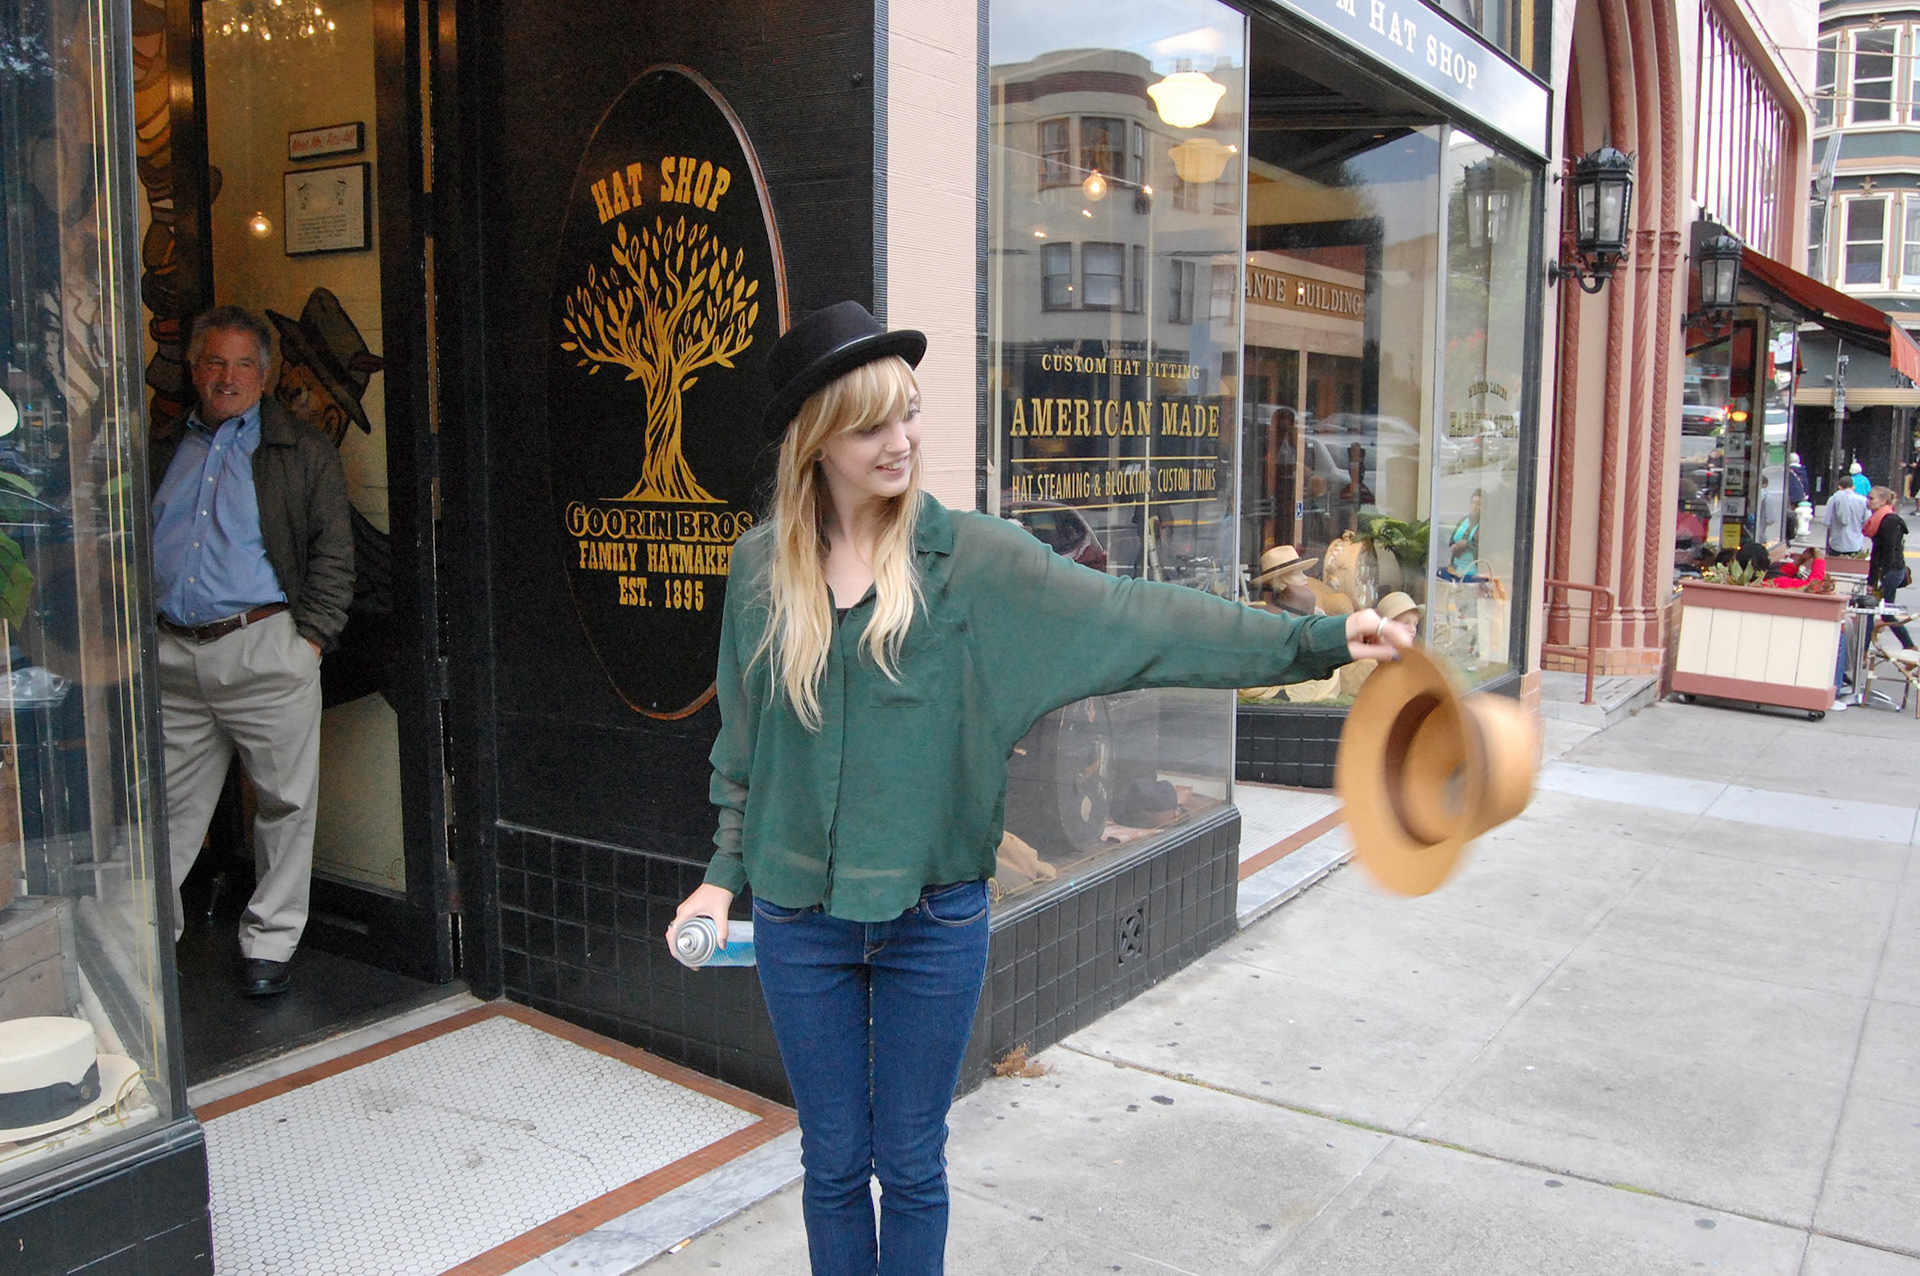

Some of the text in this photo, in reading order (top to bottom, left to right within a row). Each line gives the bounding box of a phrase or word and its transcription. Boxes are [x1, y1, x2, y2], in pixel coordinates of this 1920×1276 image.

[1369, 0, 1478, 90] HAT SHOP
[591, 156, 731, 225] HAT SHOP
[1296, 281, 1361, 315] BUILDING
[1041, 354, 1199, 380] CUSTOM HAT FITTING
[1010, 398, 1220, 438] AMERICAN MADE
[1012, 468, 1216, 502] HAT STEAMING & BLOCKING, CUSTOM TRIMS
[565, 501, 672, 540] GOORIN
[579, 540, 638, 571] FAMILY
[618, 576, 704, 612] EST. 1895
